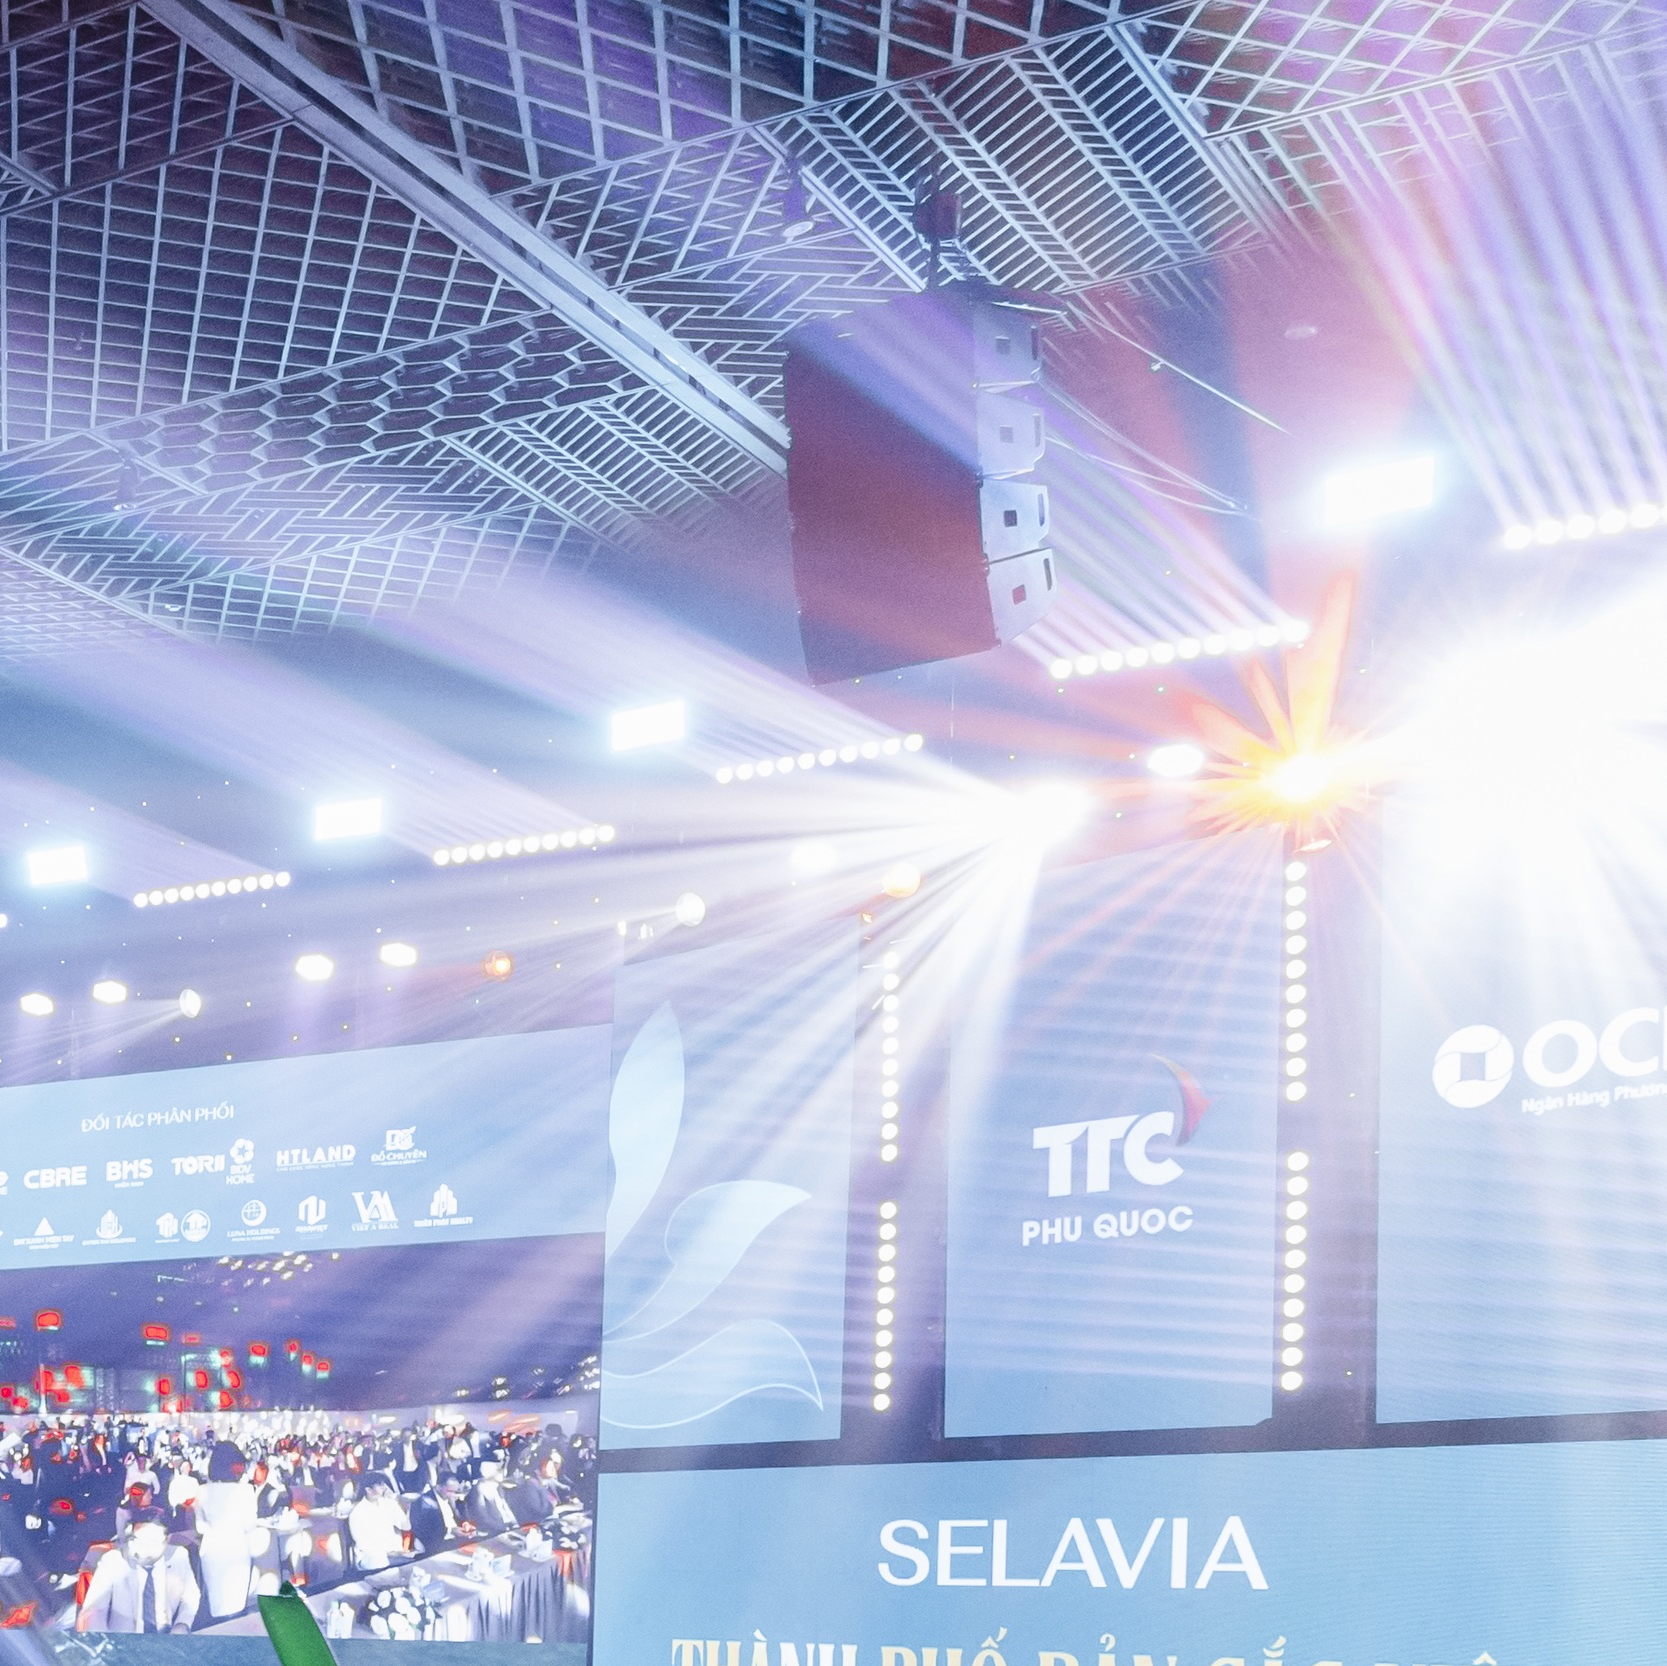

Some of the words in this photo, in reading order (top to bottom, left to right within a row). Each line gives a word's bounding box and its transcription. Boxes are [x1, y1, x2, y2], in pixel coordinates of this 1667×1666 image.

[1522, 1005, 1667, 1088] OC
[81, 1112, 110, 1133] ĐỐI
[115, 1110, 145, 1129] TÁC
[147, 1107, 192, 1126] PHÂN
[194, 1101, 235, 1122] PHỐI
[170, 1154, 226, 1176] TORII
[275, 1144, 357, 1167] HTLAND
[1032, 1110, 1184, 1197] TTC
[23, 1165, 88, 1190] CBRE
[1021, 1215, 1082, 1247] PHU
[1093, 1204, 1194, 1239] QUOC
[878, 1515, 1268, 1591] SELAVIA
